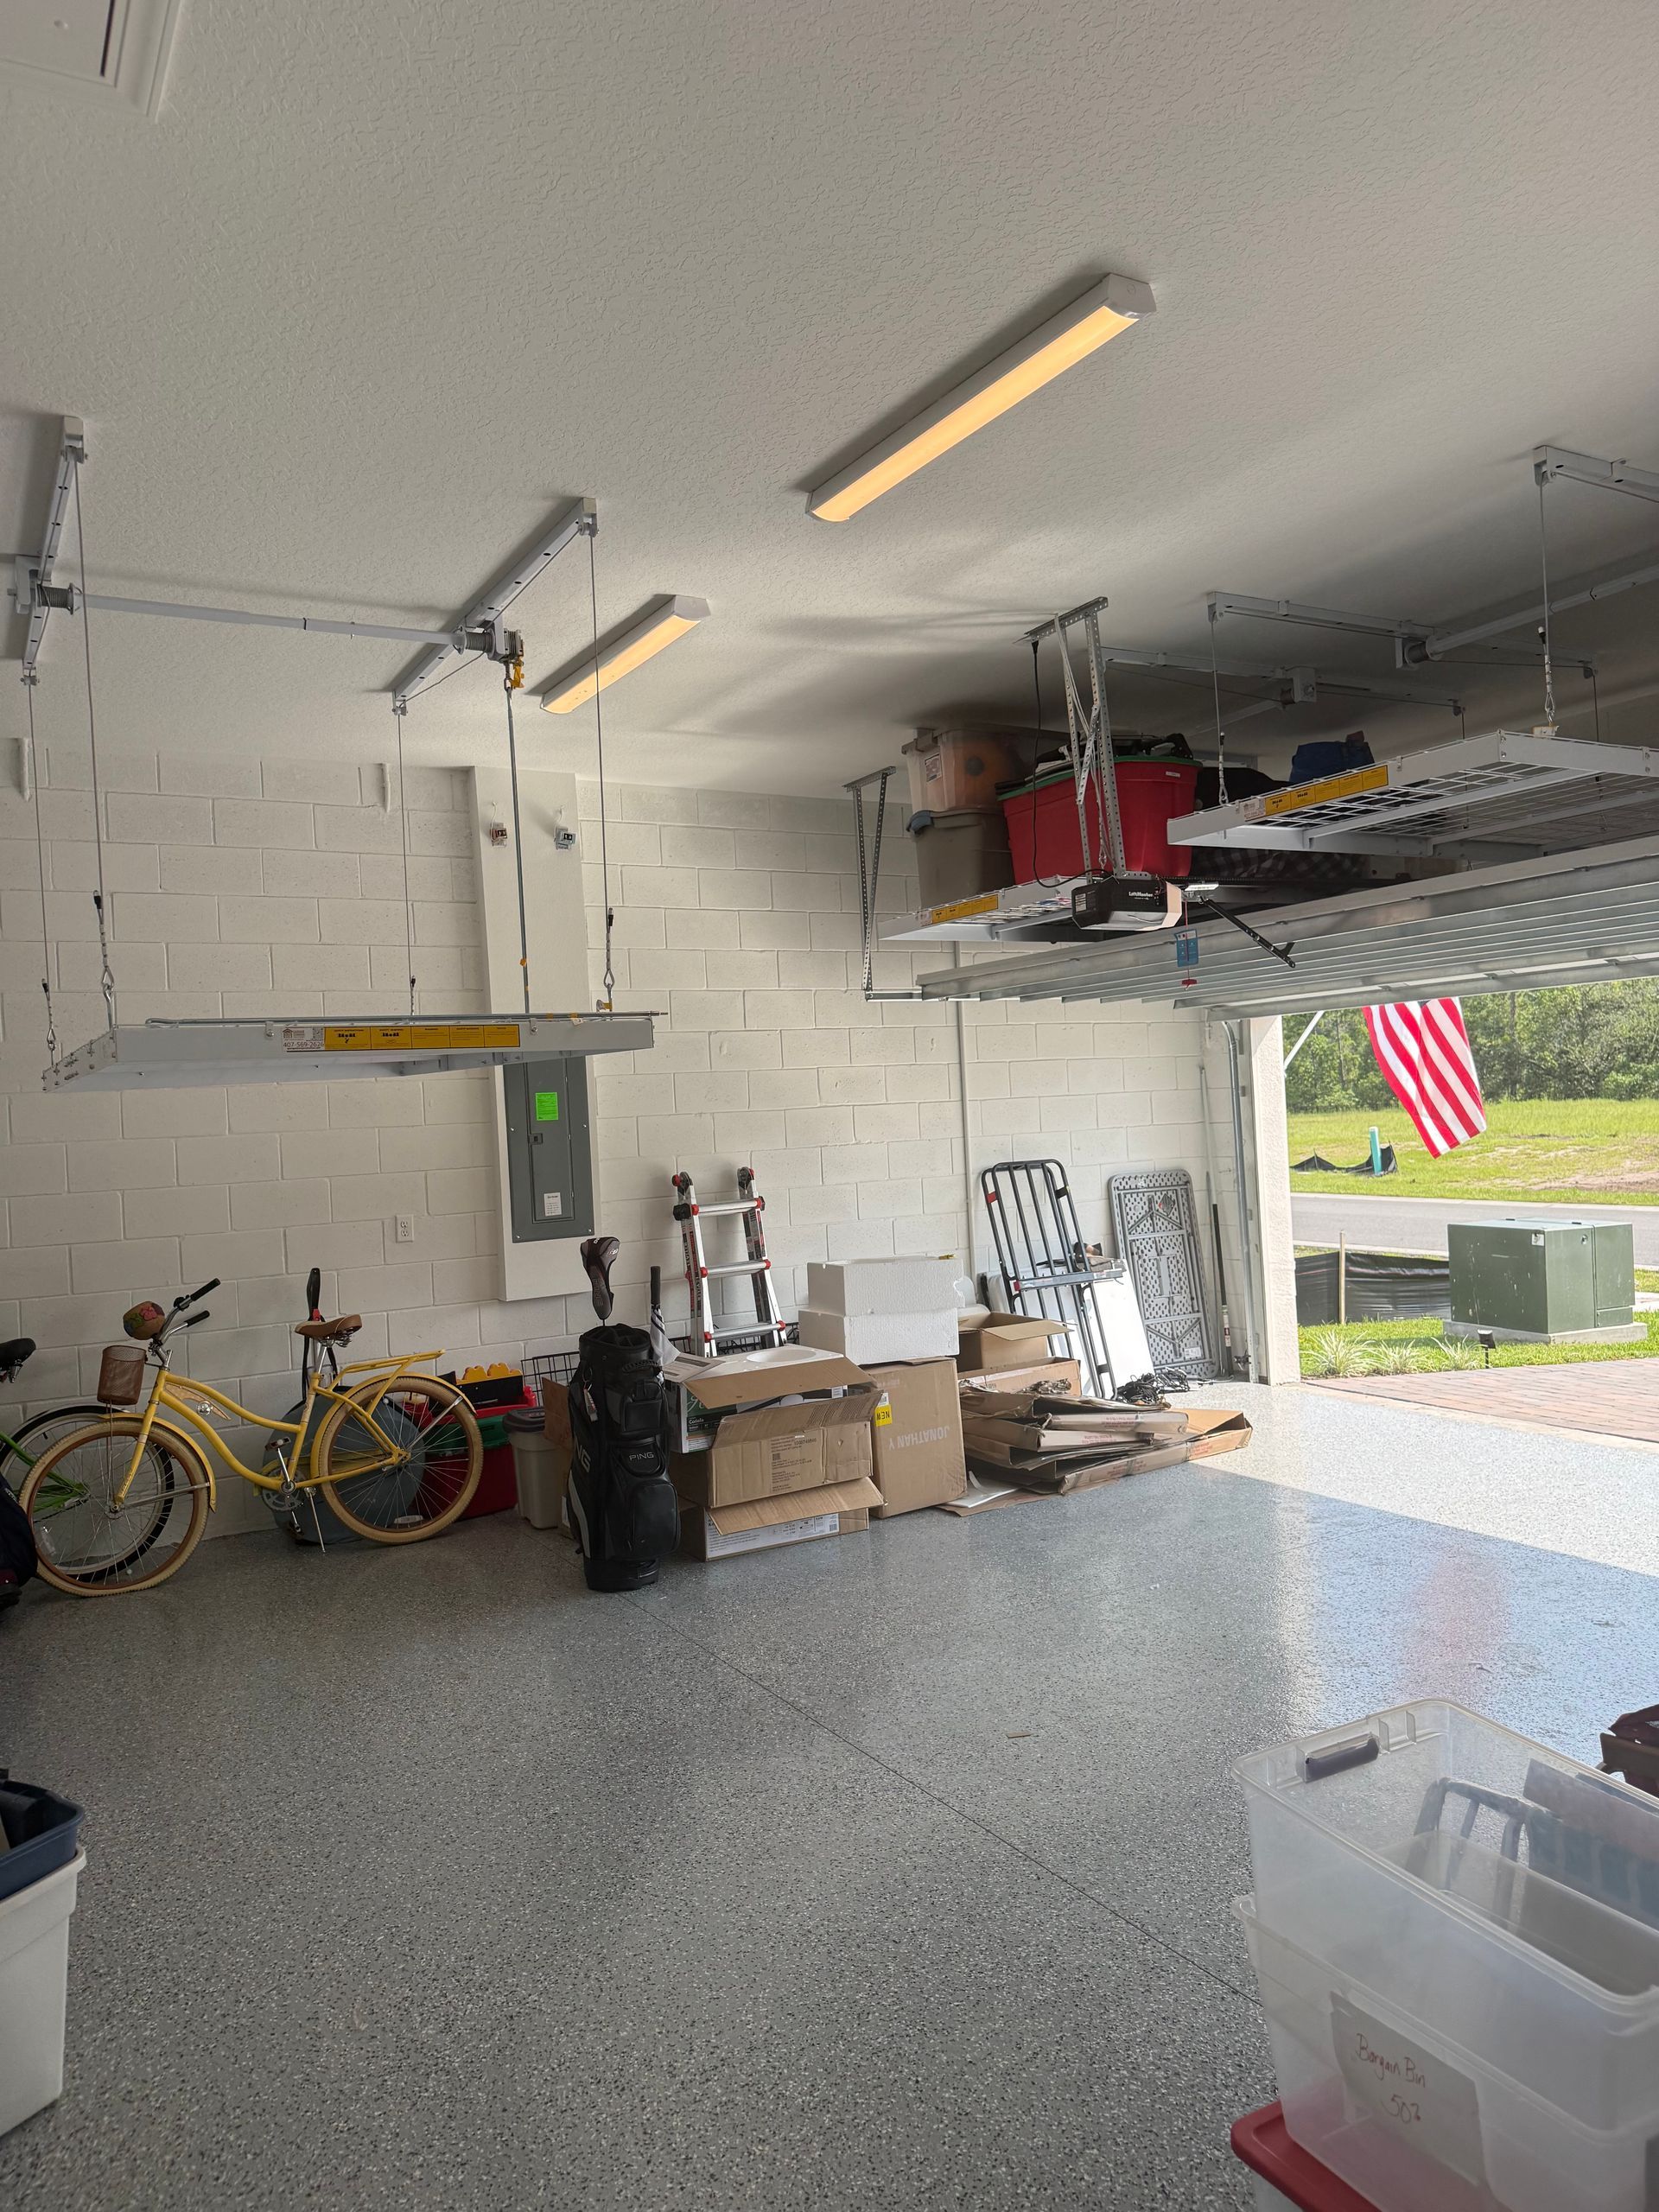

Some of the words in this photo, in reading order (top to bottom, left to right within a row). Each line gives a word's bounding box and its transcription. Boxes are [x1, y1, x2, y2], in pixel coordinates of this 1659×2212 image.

[877, 1411, 890, 1421] NEW
[887, 1437, 895, 1451] Y
[898, 1426, 950, 1448] JONATHAN
[628, 1452, 654, 1461] PING
[1355, 2033, 1401, 2081] Bargain
[1403, 2056, 1426, 2088] Bin
